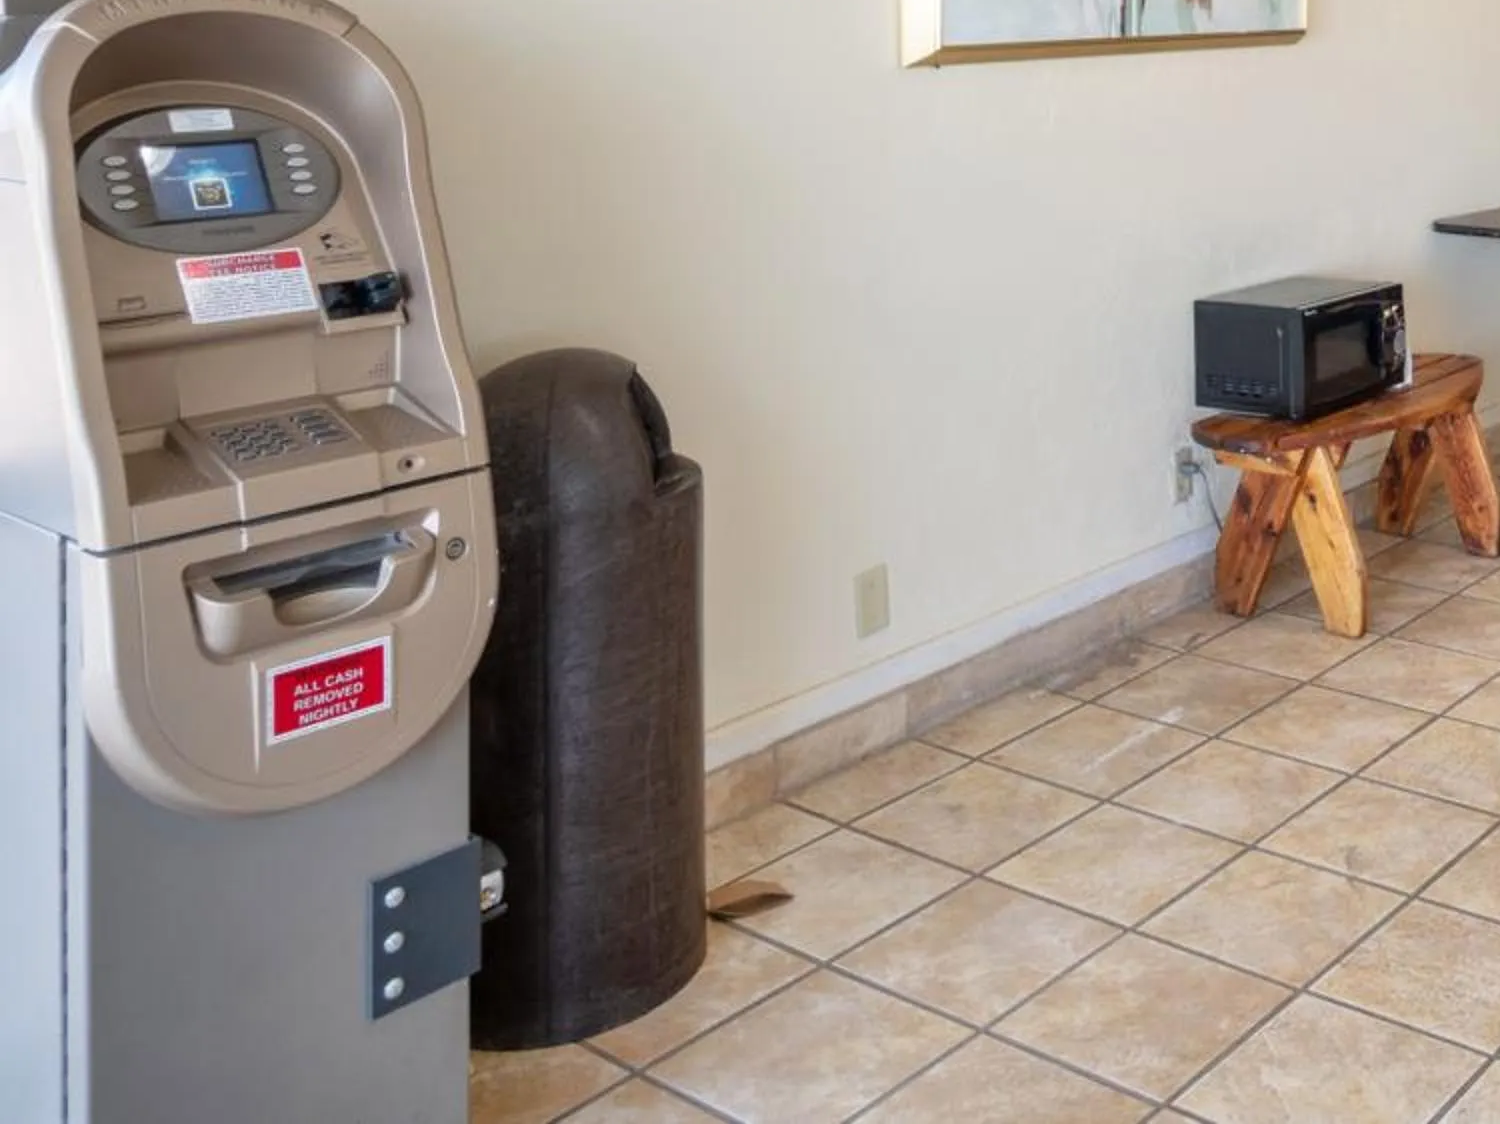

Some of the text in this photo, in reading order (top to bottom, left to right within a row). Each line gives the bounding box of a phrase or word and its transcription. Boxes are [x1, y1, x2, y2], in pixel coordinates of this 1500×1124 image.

[293, 682, 364, 712] REMOVED
[294, 667, 364, 697] ALL CASH
[299, 698, 359, 725] NIGHTLY
